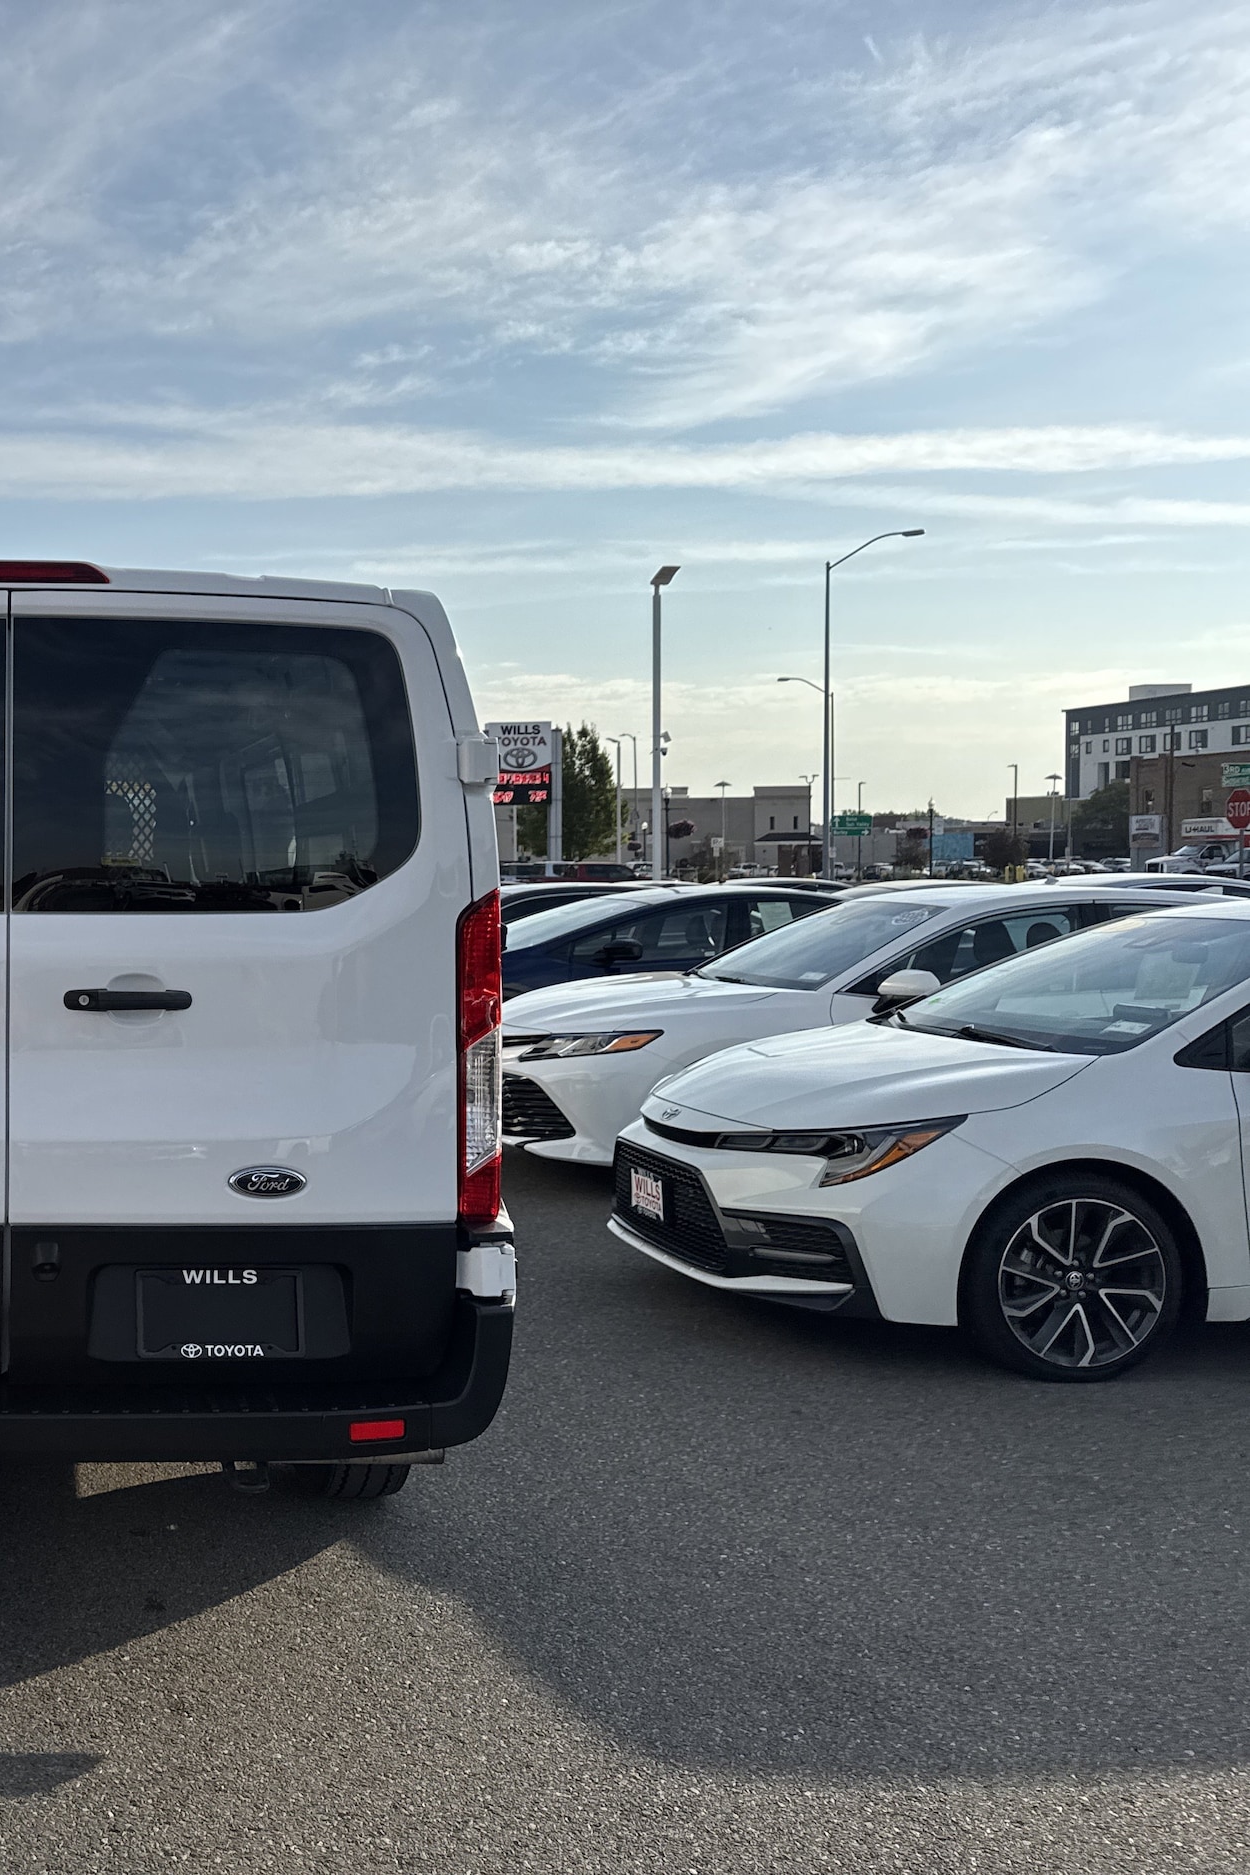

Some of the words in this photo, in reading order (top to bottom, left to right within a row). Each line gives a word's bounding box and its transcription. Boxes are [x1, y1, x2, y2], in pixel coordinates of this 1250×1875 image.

[500, 724, 541, 735] WILLS
[498, 736, 547, 747] OYOTA
[247, 1173, 289, 1191] Ford
[634, 1175, 661, 1201] WILLS
[640, 1195, 661, 1211] TOYOTA
[182, 1269, 258, 1284] WILLS
[205, 1345, 264, 1357] TOYOTA
